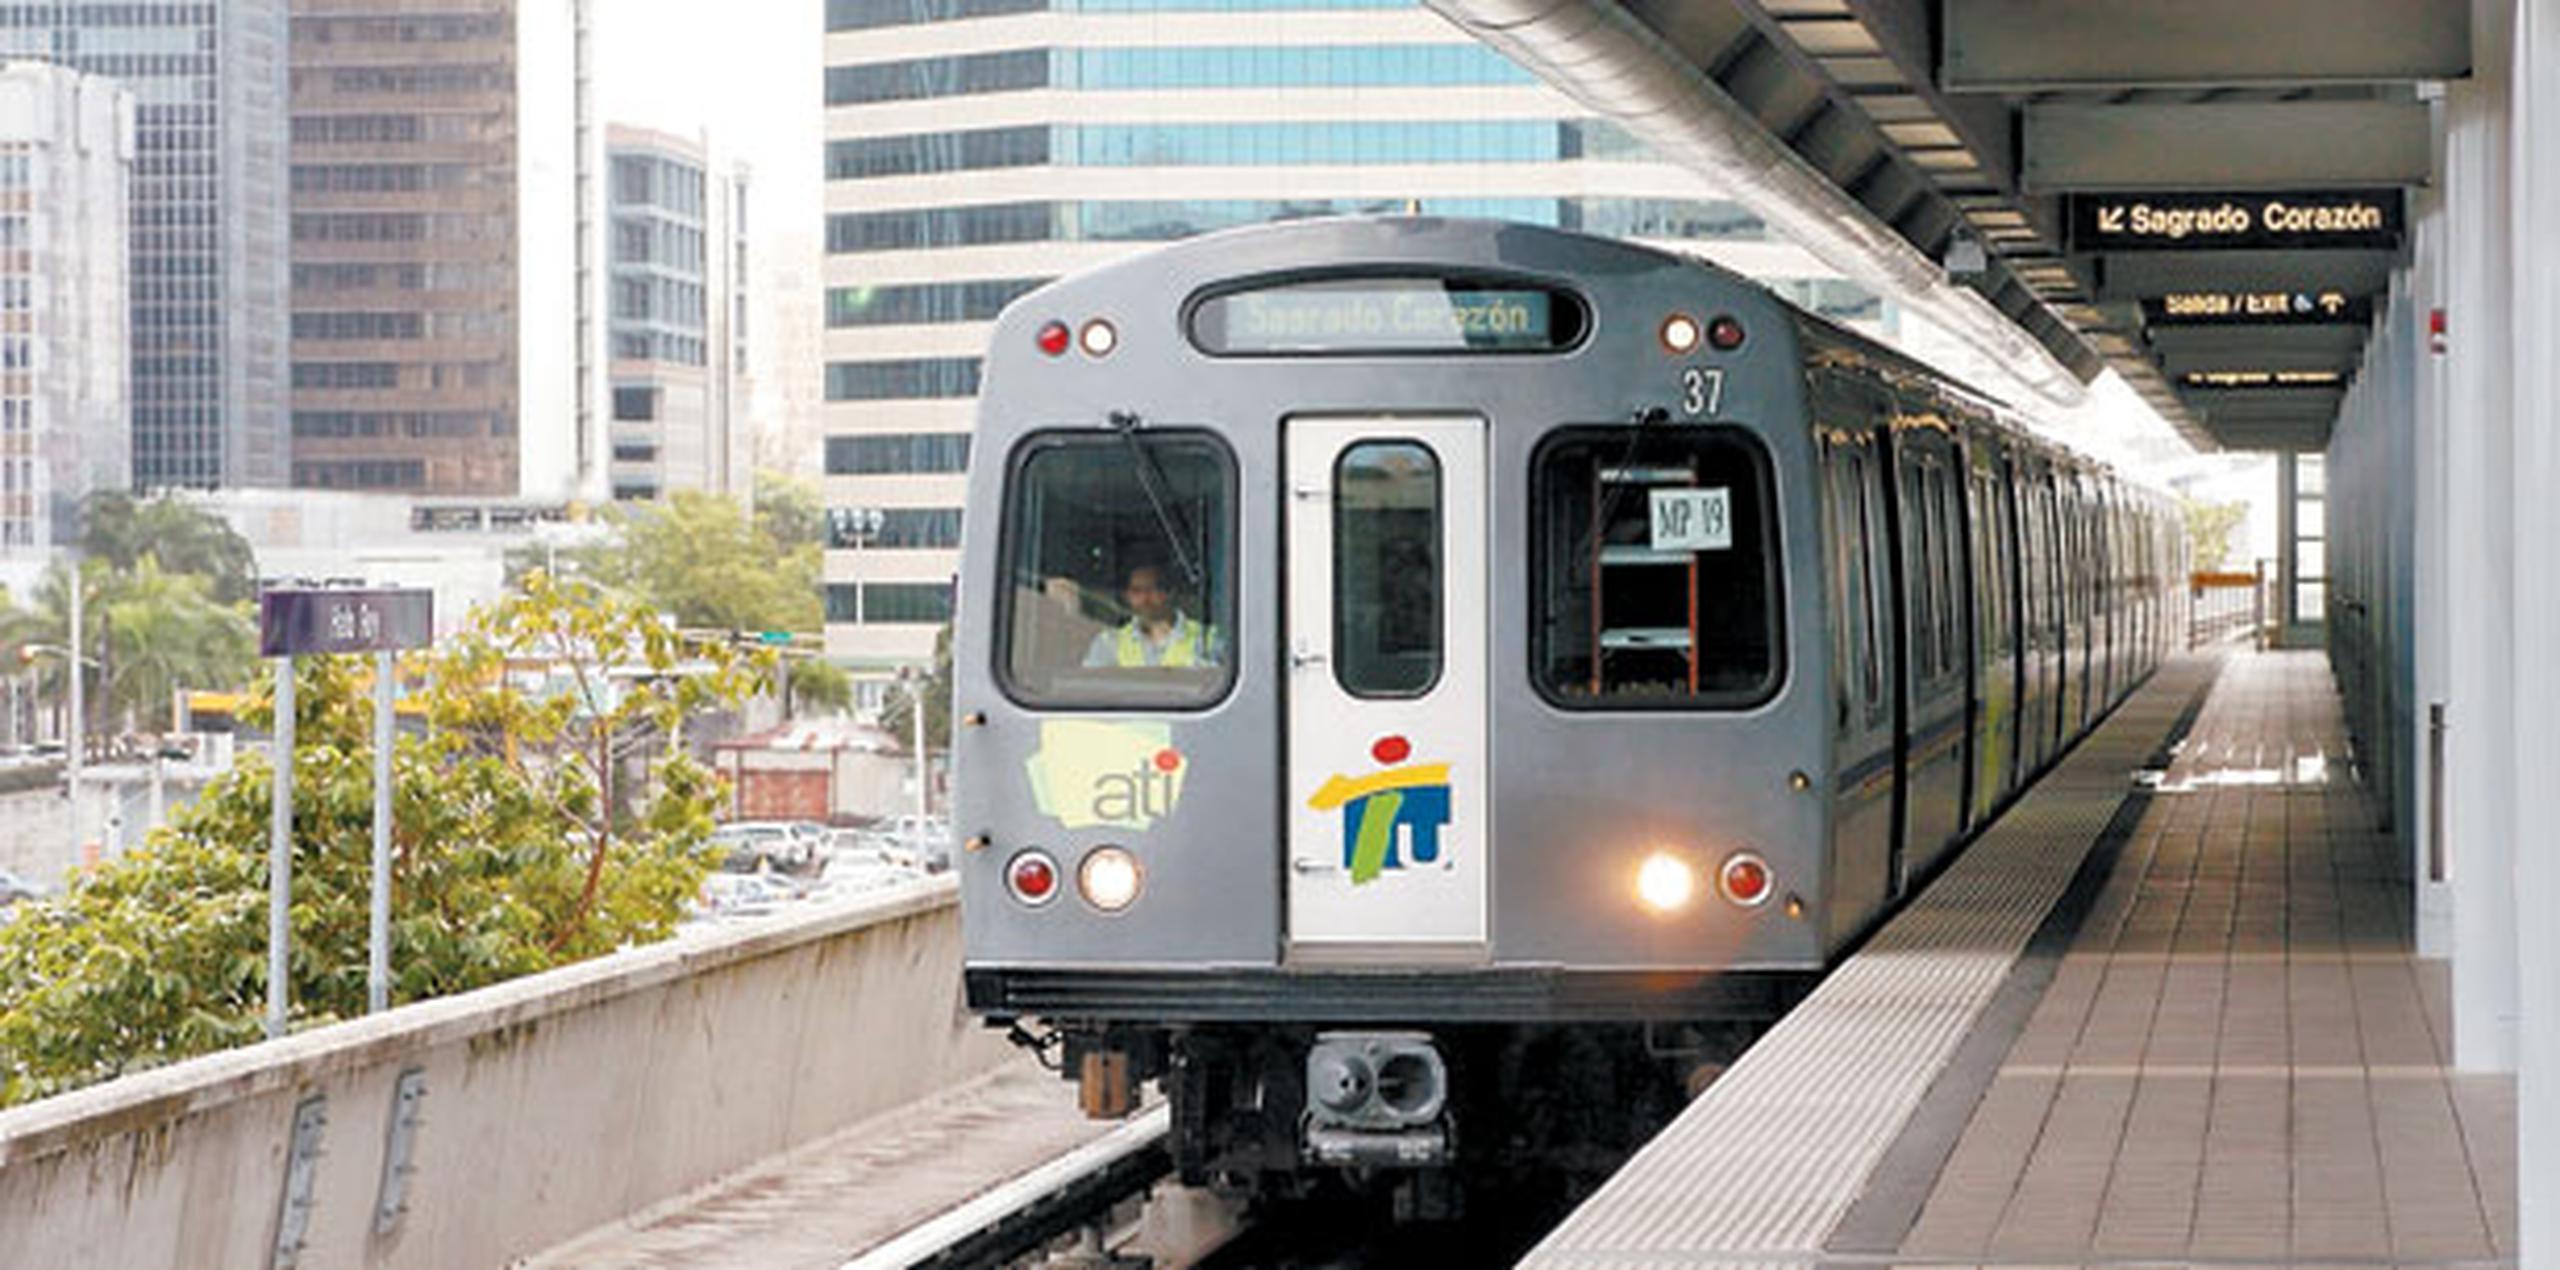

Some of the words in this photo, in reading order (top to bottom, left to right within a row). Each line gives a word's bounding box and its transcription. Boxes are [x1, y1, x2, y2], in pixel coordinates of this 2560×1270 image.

[2130, 203, 2250, 238] Sagrado
[2262, 202, 2382, 232] Corazón
[1392, 295, 1529, 333] Corazón
[1683, 369, 1723, 415] 37
[1658, 499, 1691, 538] MP
[1092, 749, 1180, 822] ati
